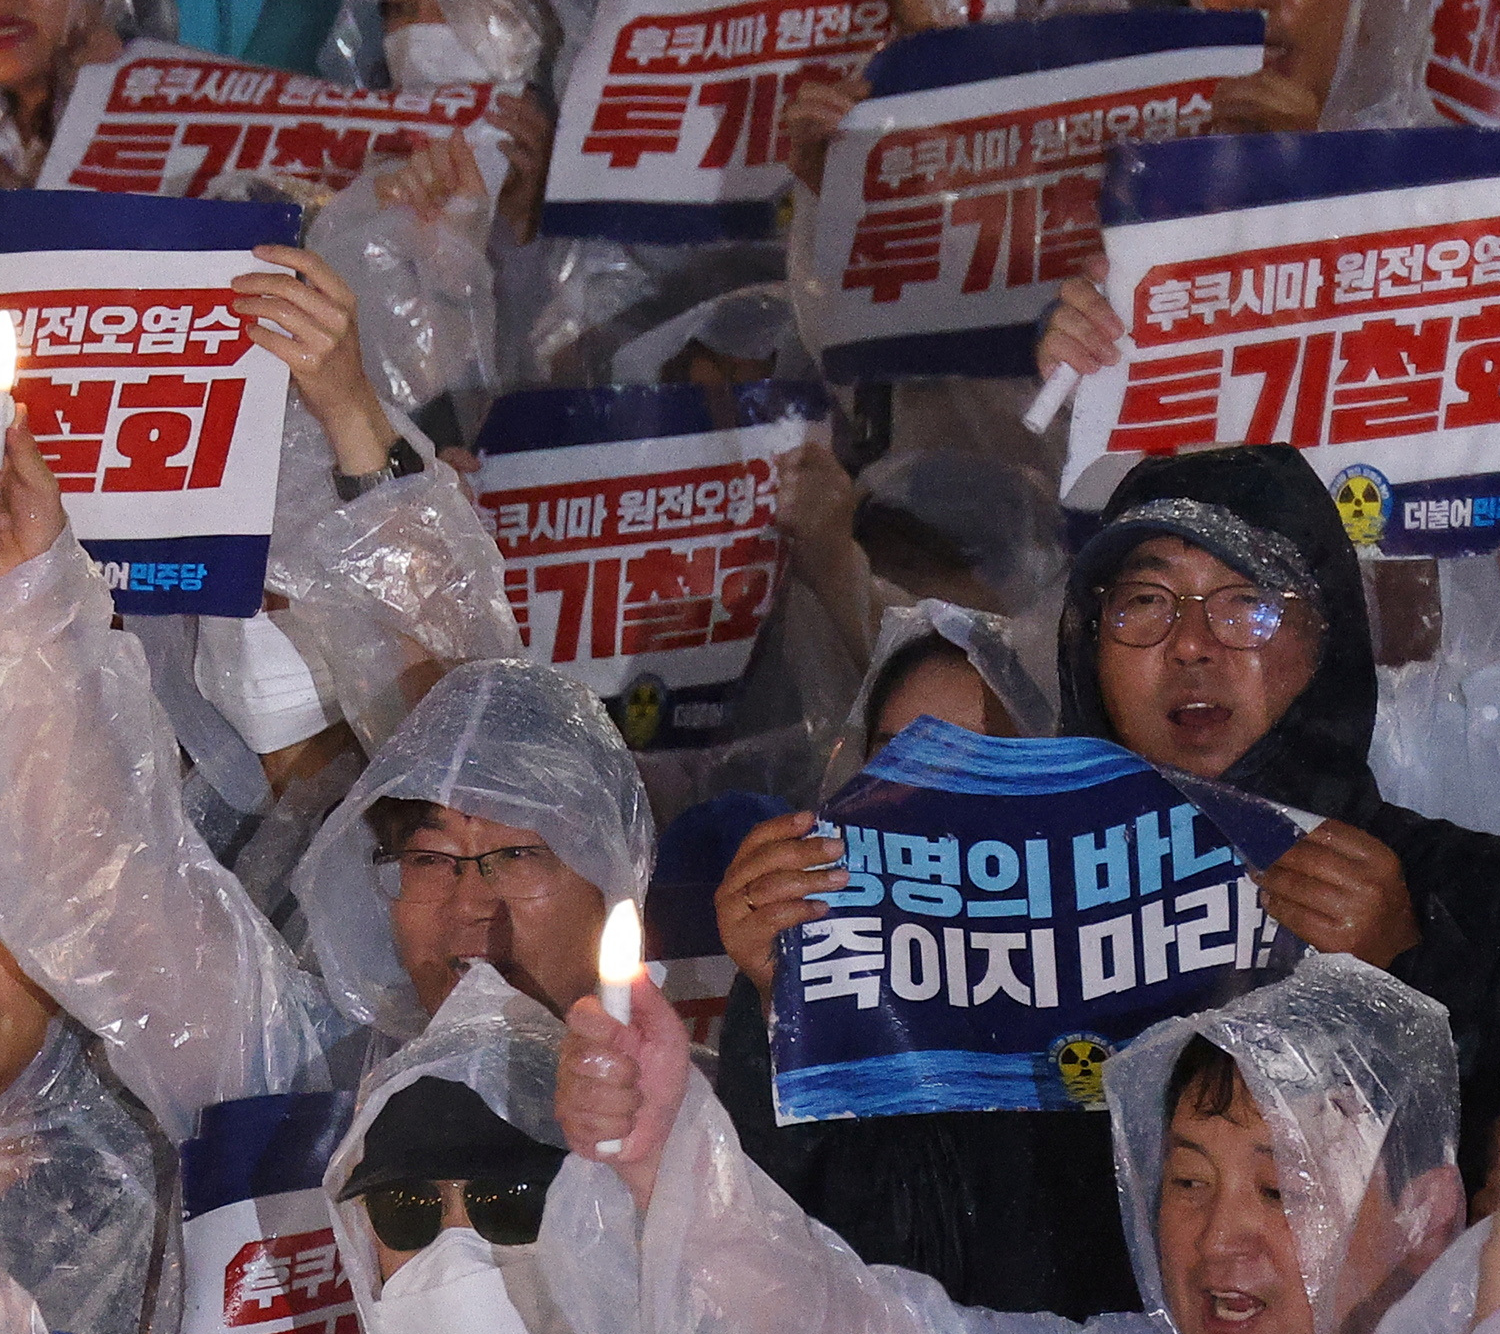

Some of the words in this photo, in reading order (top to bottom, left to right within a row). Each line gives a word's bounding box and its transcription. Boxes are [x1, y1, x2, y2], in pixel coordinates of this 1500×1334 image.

[627, 11, 767, 66] 후쿠시마
[777, 0, 894, 52] 원전오
[121, 61, 275, 112] 후쿠시마
[879, 128, 1021, 188] 후쿠시마
[1030, 93, 1213, 158] 원전오염수
[842, 170, 1104, 304] 투기철
[1147, 261, 1325, 330] 후쿠시마
[88, 561, 208, 593] 어민주당
[801, 916, 1060, 1010] 죽이지
